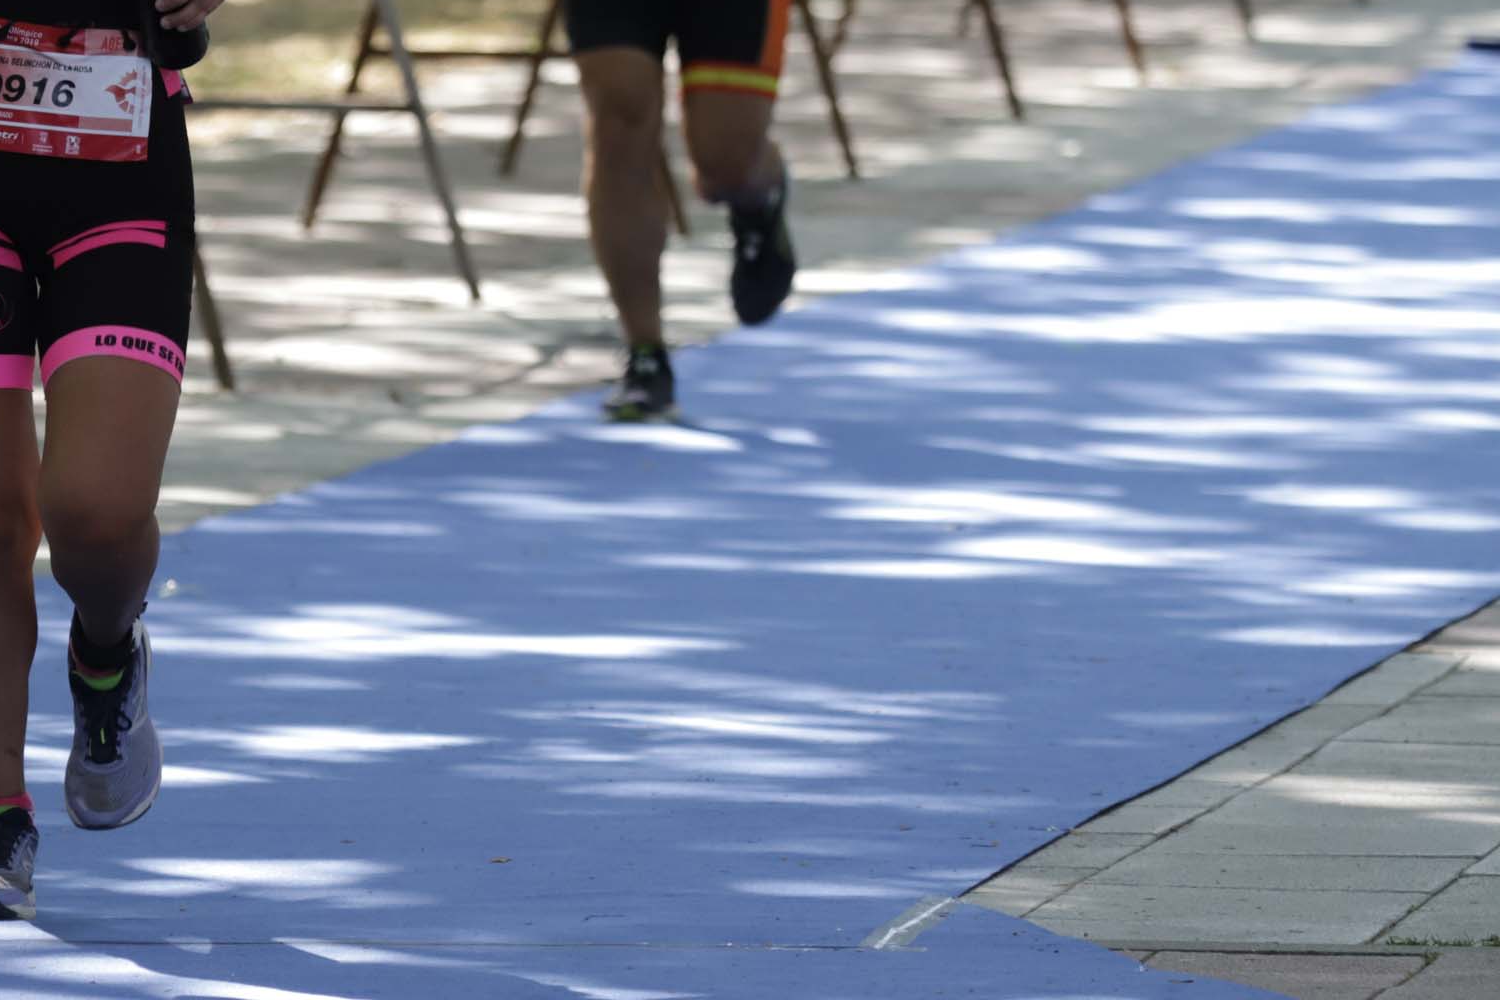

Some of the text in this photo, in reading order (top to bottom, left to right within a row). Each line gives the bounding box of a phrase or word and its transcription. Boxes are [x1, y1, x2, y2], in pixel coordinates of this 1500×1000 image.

[95, 334, 175, 364] LO QUE SE
